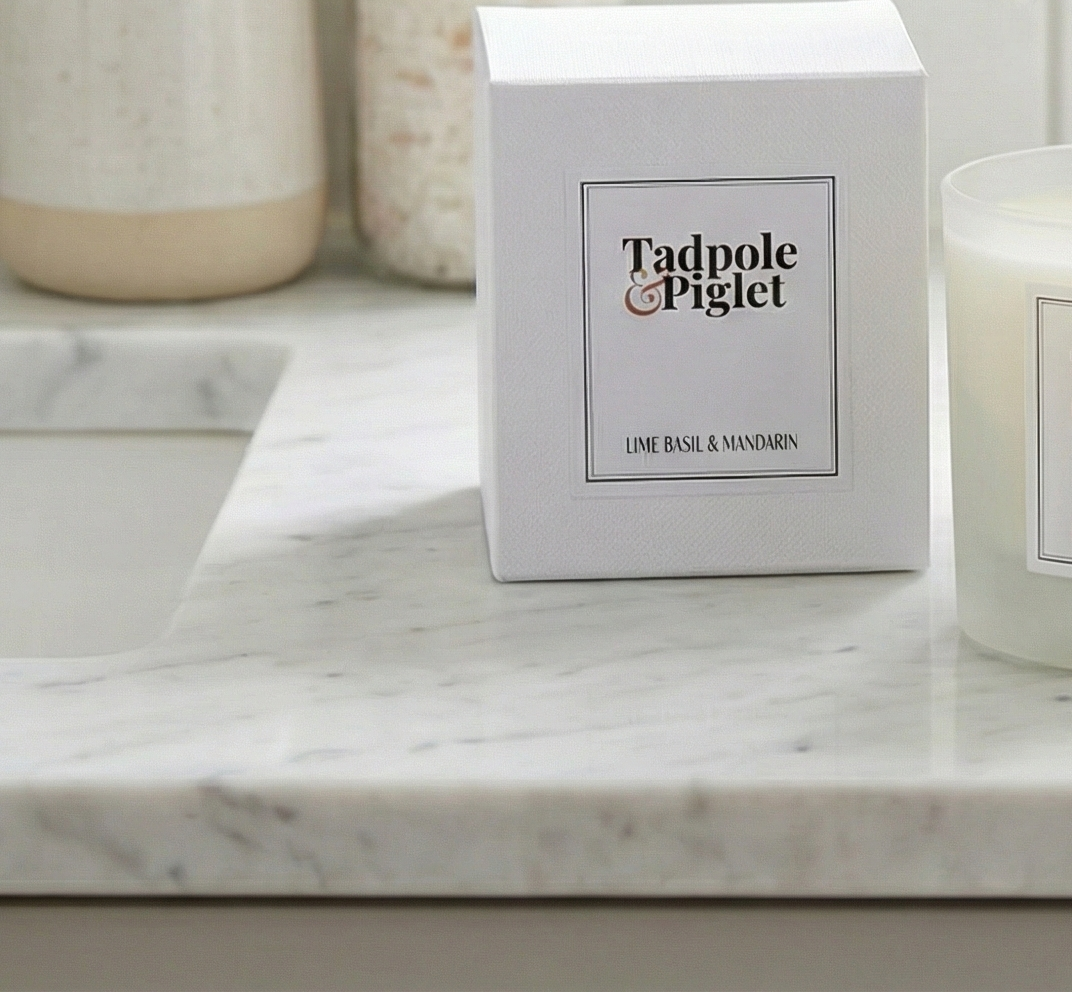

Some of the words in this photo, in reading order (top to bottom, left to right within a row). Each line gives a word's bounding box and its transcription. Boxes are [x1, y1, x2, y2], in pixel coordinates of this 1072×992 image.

[622, 231, 798, 279] Tadpole
[661, 272, 787, 317] Piglet
[626, 436, 660, 454] LIME
[664, 435, 704, 453] BASIL
[707, 434, 719, 452] &
[722, 433, 798, 452] MANDARIN
